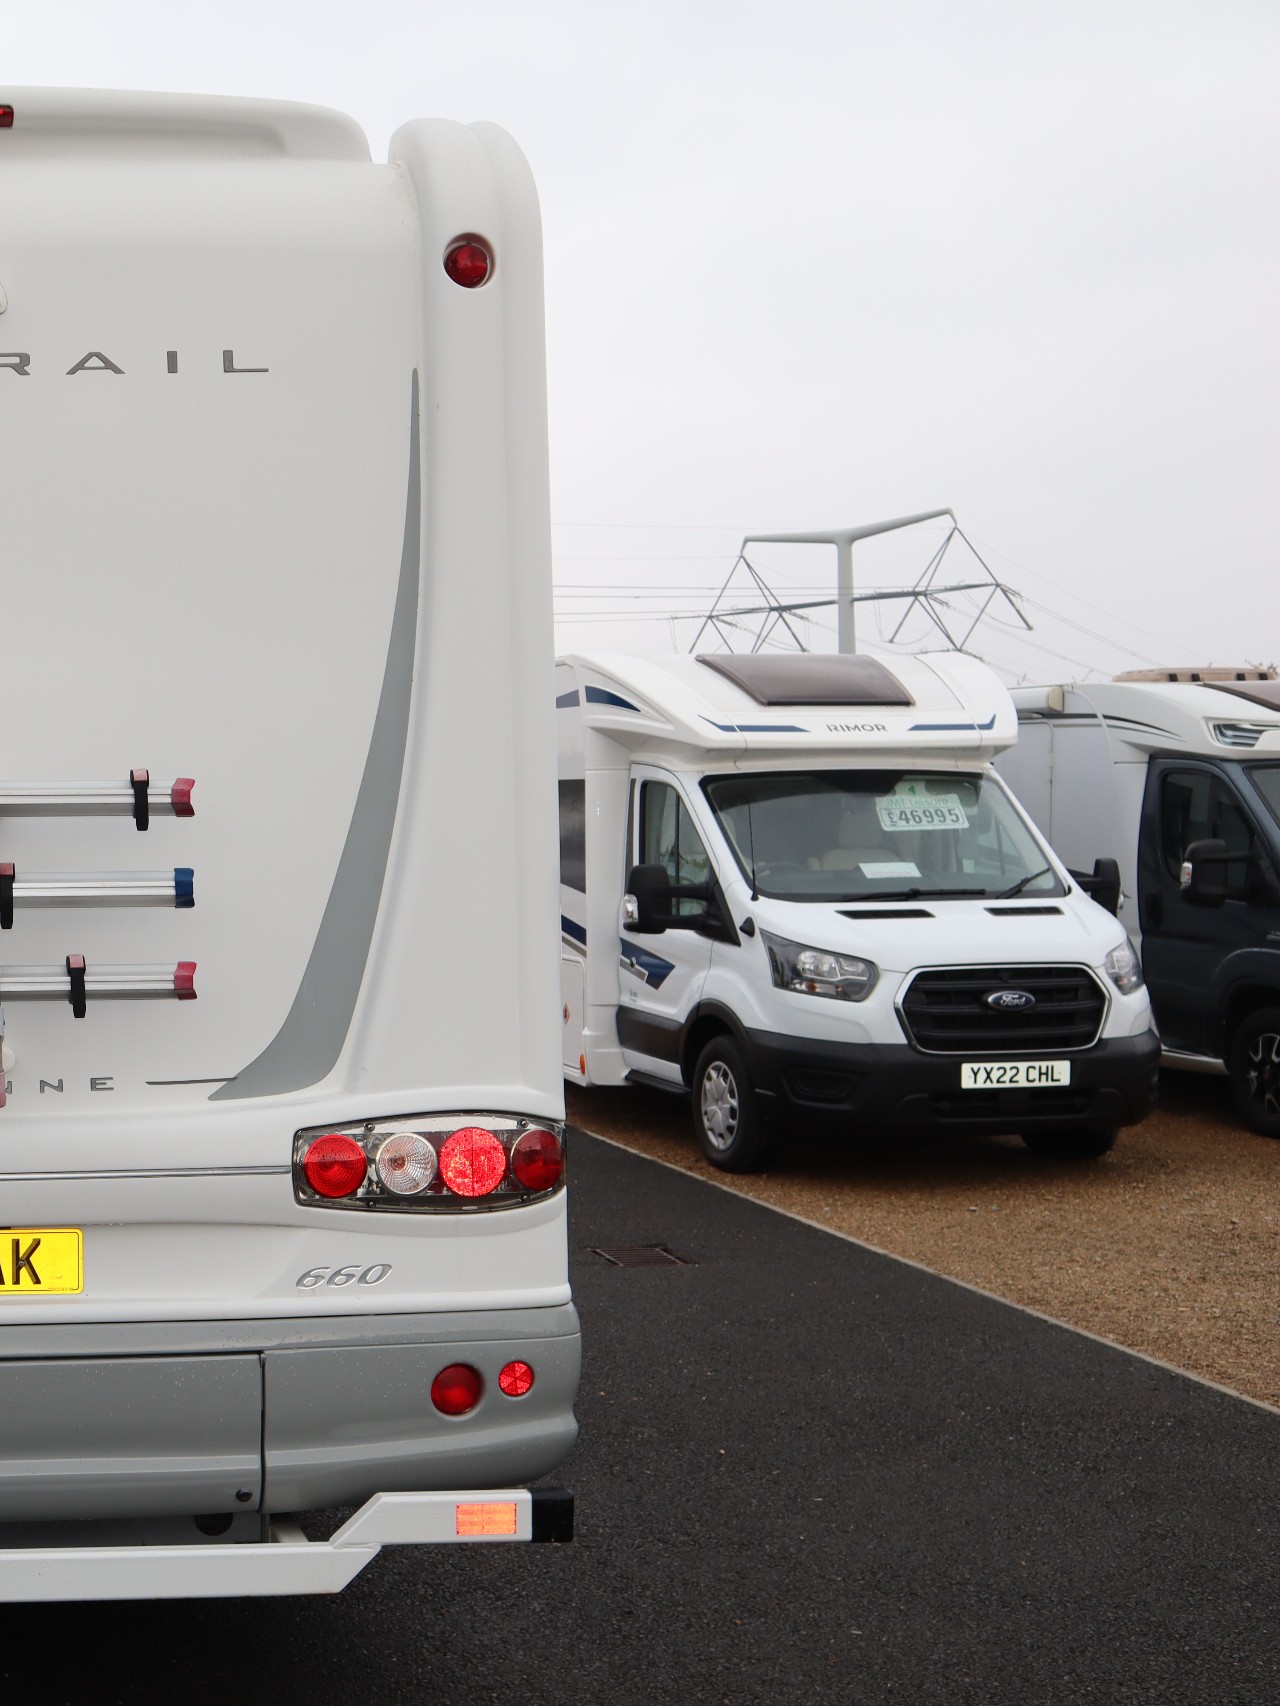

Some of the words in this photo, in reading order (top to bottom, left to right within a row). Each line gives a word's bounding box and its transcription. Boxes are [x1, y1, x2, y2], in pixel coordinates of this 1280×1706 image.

[825, 723, 888, 733] RIMOR
[887, 808, 961, 827] £46995
[1000, 993, 1026, 1006] Ford
[970, 1066, 1020, 1085] YX22
[1025, 1064, 1062, 1083] CHL
[295, 1263, 393, 1290] 660
